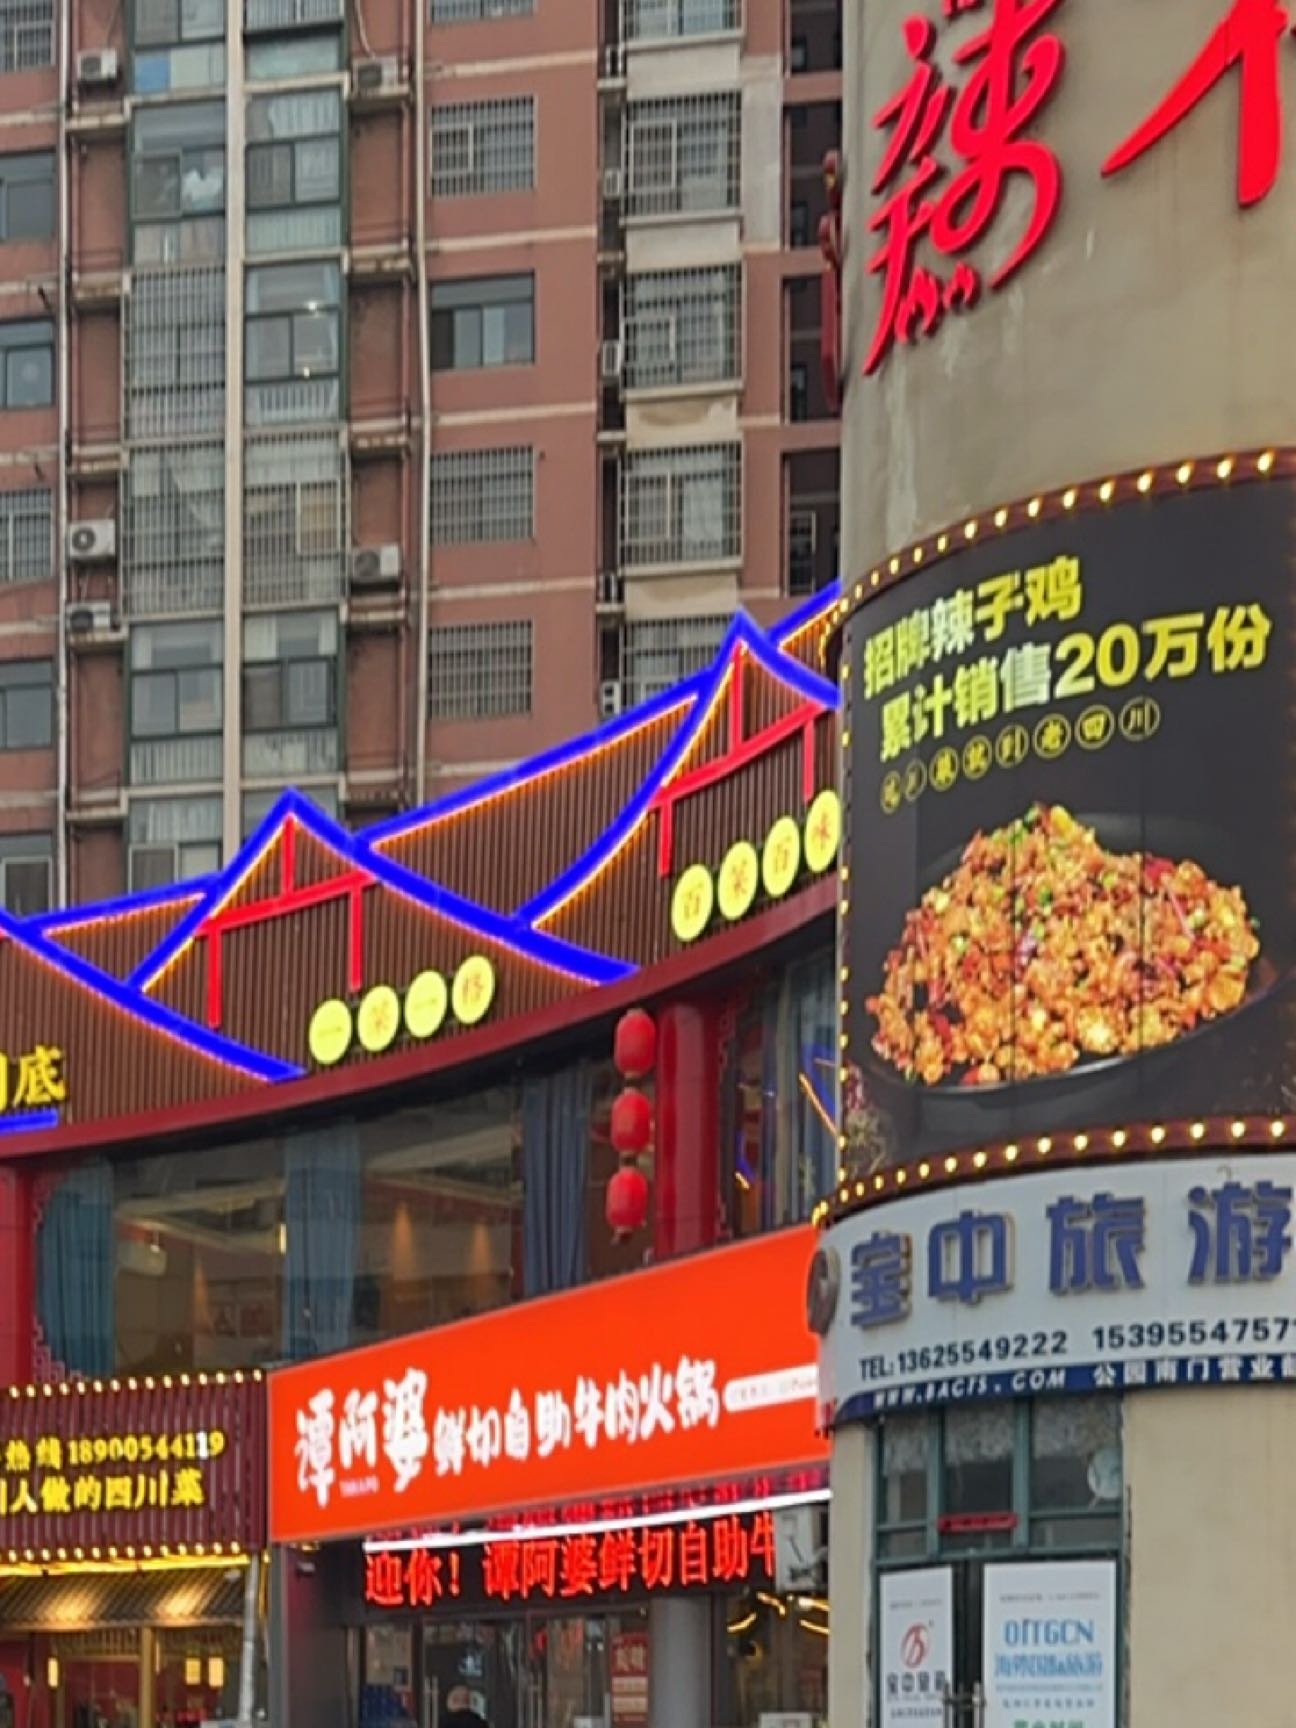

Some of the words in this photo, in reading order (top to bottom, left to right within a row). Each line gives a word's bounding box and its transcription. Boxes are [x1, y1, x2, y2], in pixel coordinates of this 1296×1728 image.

[863, 556, 1082, 698] 招牌辣子鸡
[880, 603, 1271, 762] 累计销售20万份
[850, 1180, 1293, 1327] 宝中旅游
[1093, 1316, 1296, 1351] 1539554757
[433, 1356, 719, 1476] 鲜切自助牛肉火锅
